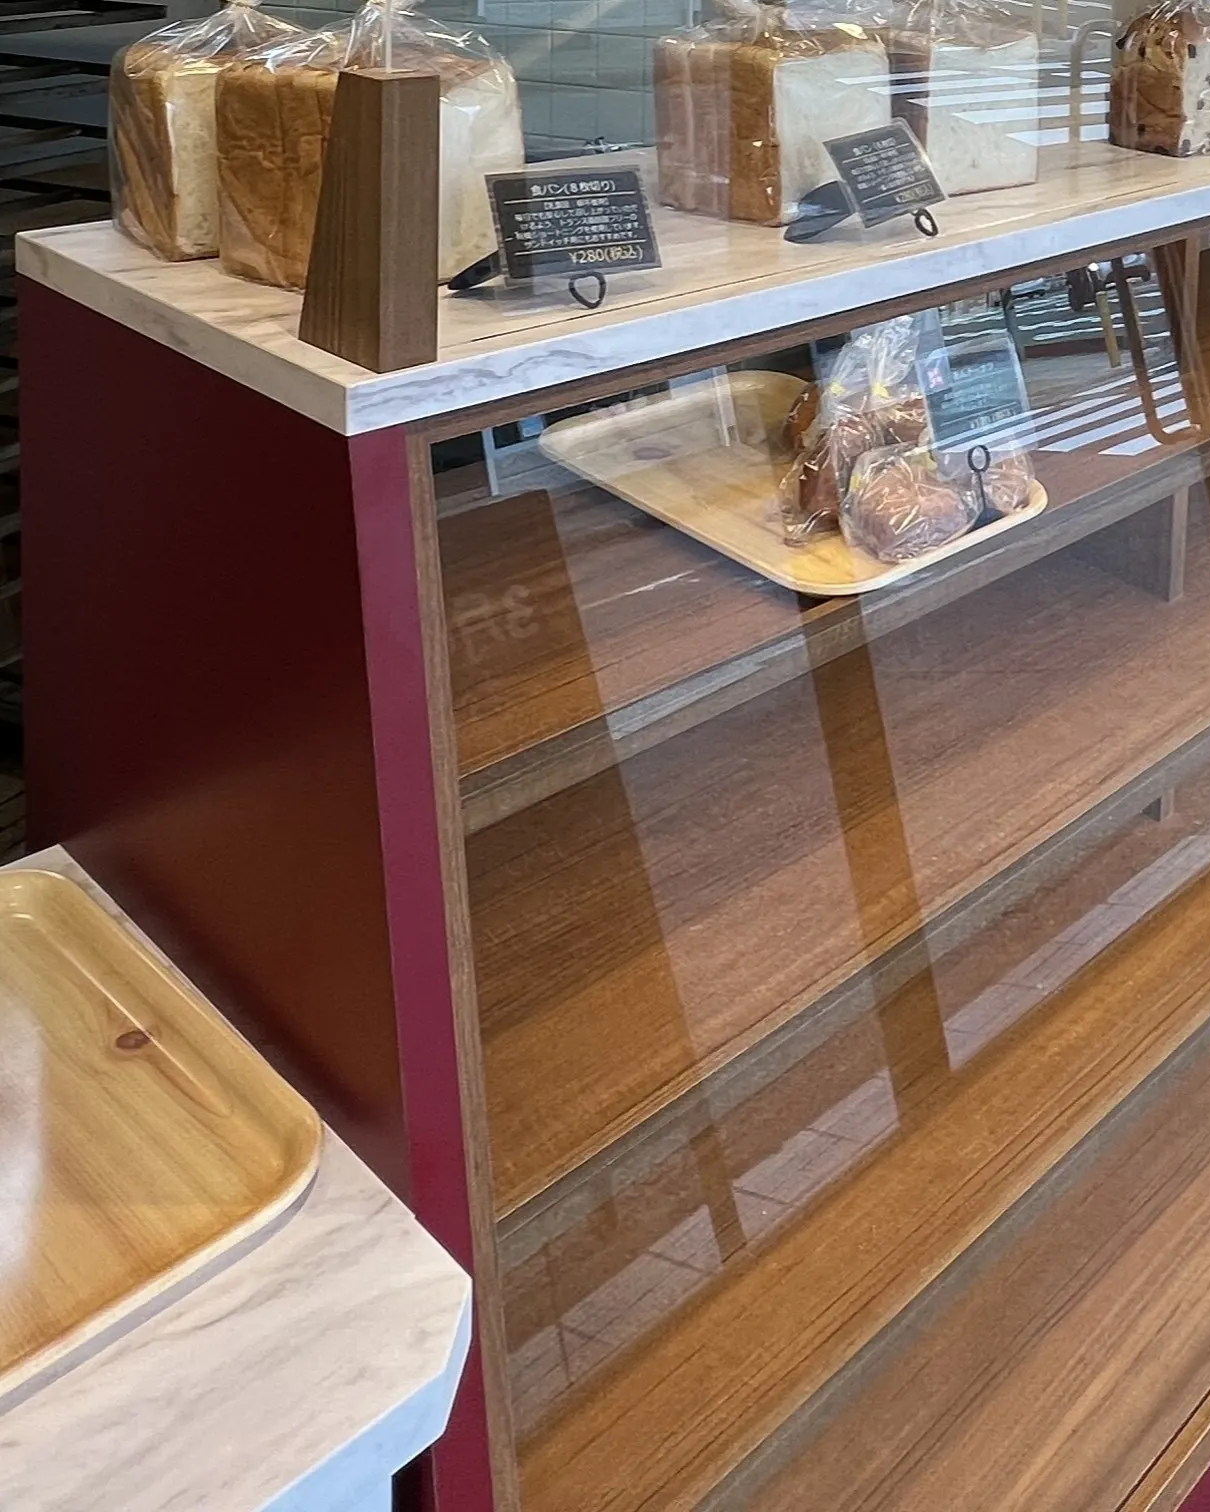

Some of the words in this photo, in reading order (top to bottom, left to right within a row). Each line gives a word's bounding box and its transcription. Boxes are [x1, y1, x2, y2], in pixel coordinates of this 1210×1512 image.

[531, 180, 616, 196] 食パン(8枚切り)
